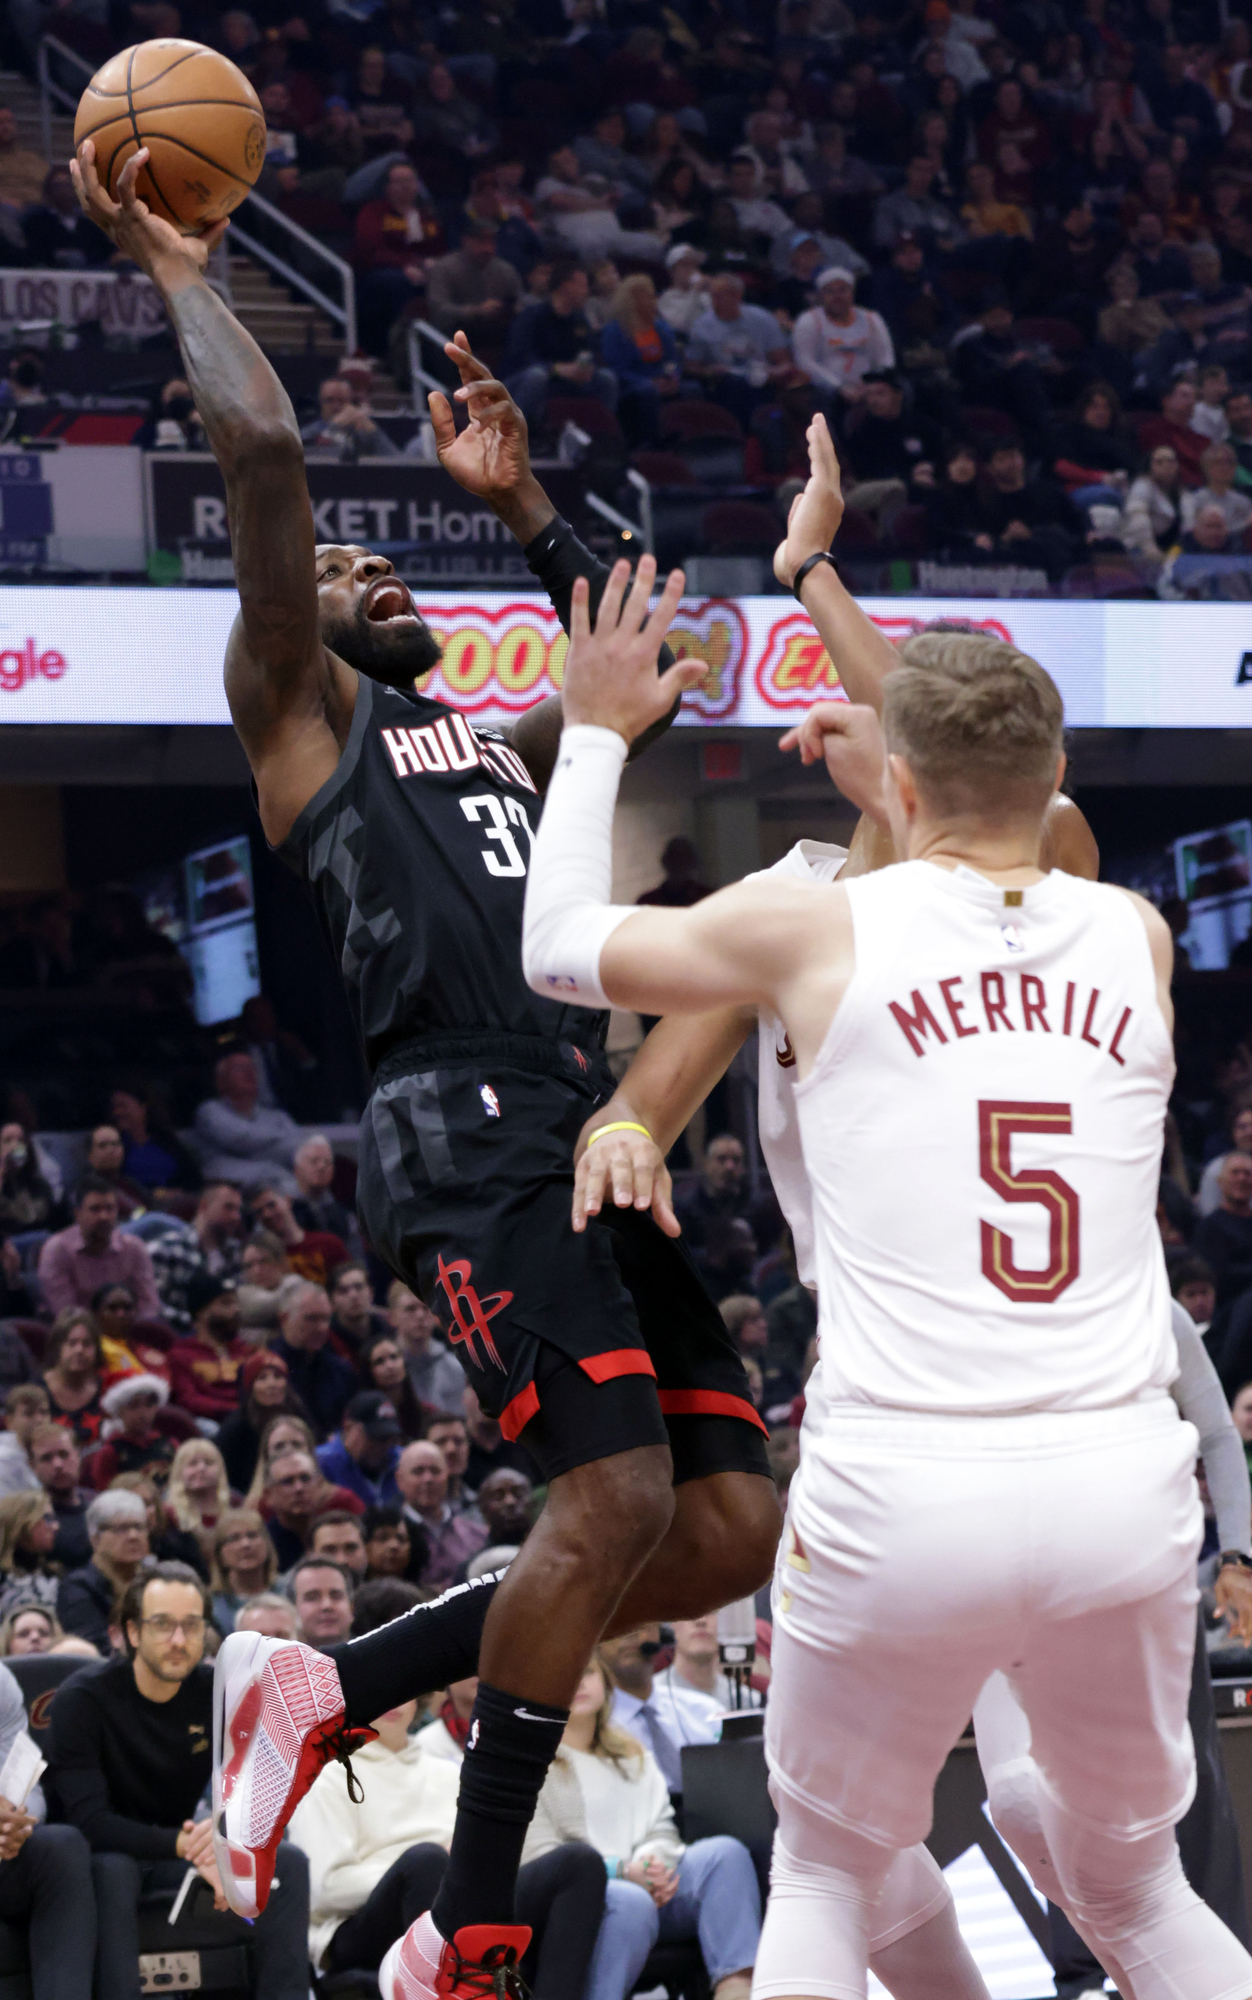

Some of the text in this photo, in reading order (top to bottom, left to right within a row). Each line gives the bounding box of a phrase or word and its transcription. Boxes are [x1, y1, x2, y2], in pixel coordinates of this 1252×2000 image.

[194, 496, 513, 543] RKET Hom
[382, 713, 539, 794] HOUTO
[887, 971, 1133, 1067] MERRILL
[977, 1099, 1080, 1304] 5
